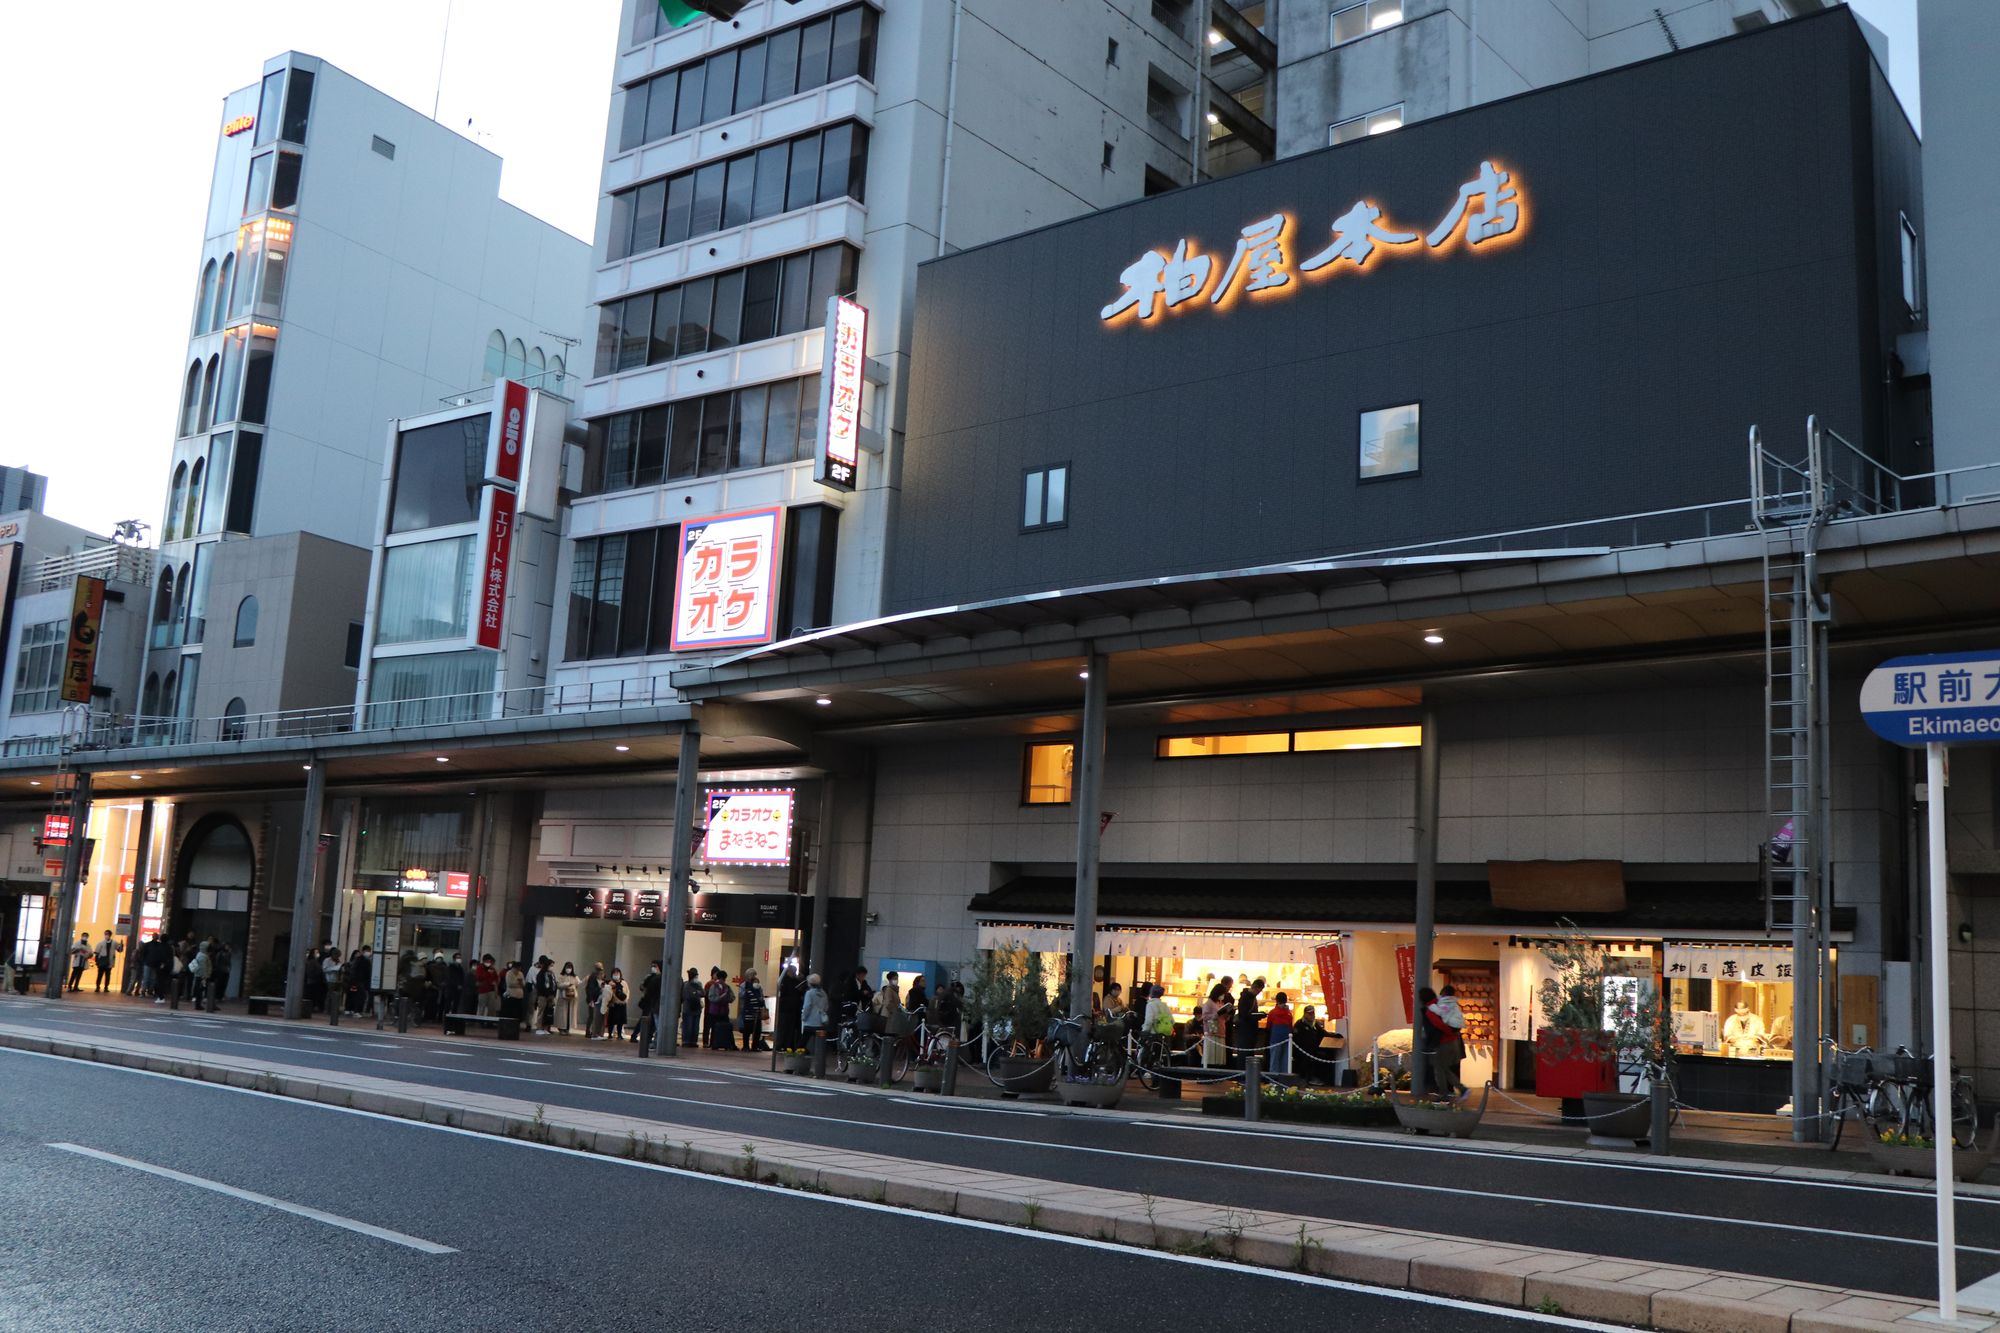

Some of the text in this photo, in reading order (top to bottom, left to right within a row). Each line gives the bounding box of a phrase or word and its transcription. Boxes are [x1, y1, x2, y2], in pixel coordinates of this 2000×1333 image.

[224, 116, 254, 137] elite
[1101, 161, 1518, 319] 柏屋本店
[834, 321, 859, 440] カラオケ
[505, 407, 521, 456] elite
[831, 464, 851, 481] 2F
[687, 530, 704, 541] 2F
[484, 510, 509, 629] エリート株式会社
[693, 538, 760, 583] カラ
[689, 588, 756, 630] オケ
[712, 799, 726, 809] 2F
[730, 808, 772, 821] カラオケ
[719, 829, 779, 850] まねきねこ
[1670, 960, 1822, 978] 柏屋薄皮饅
